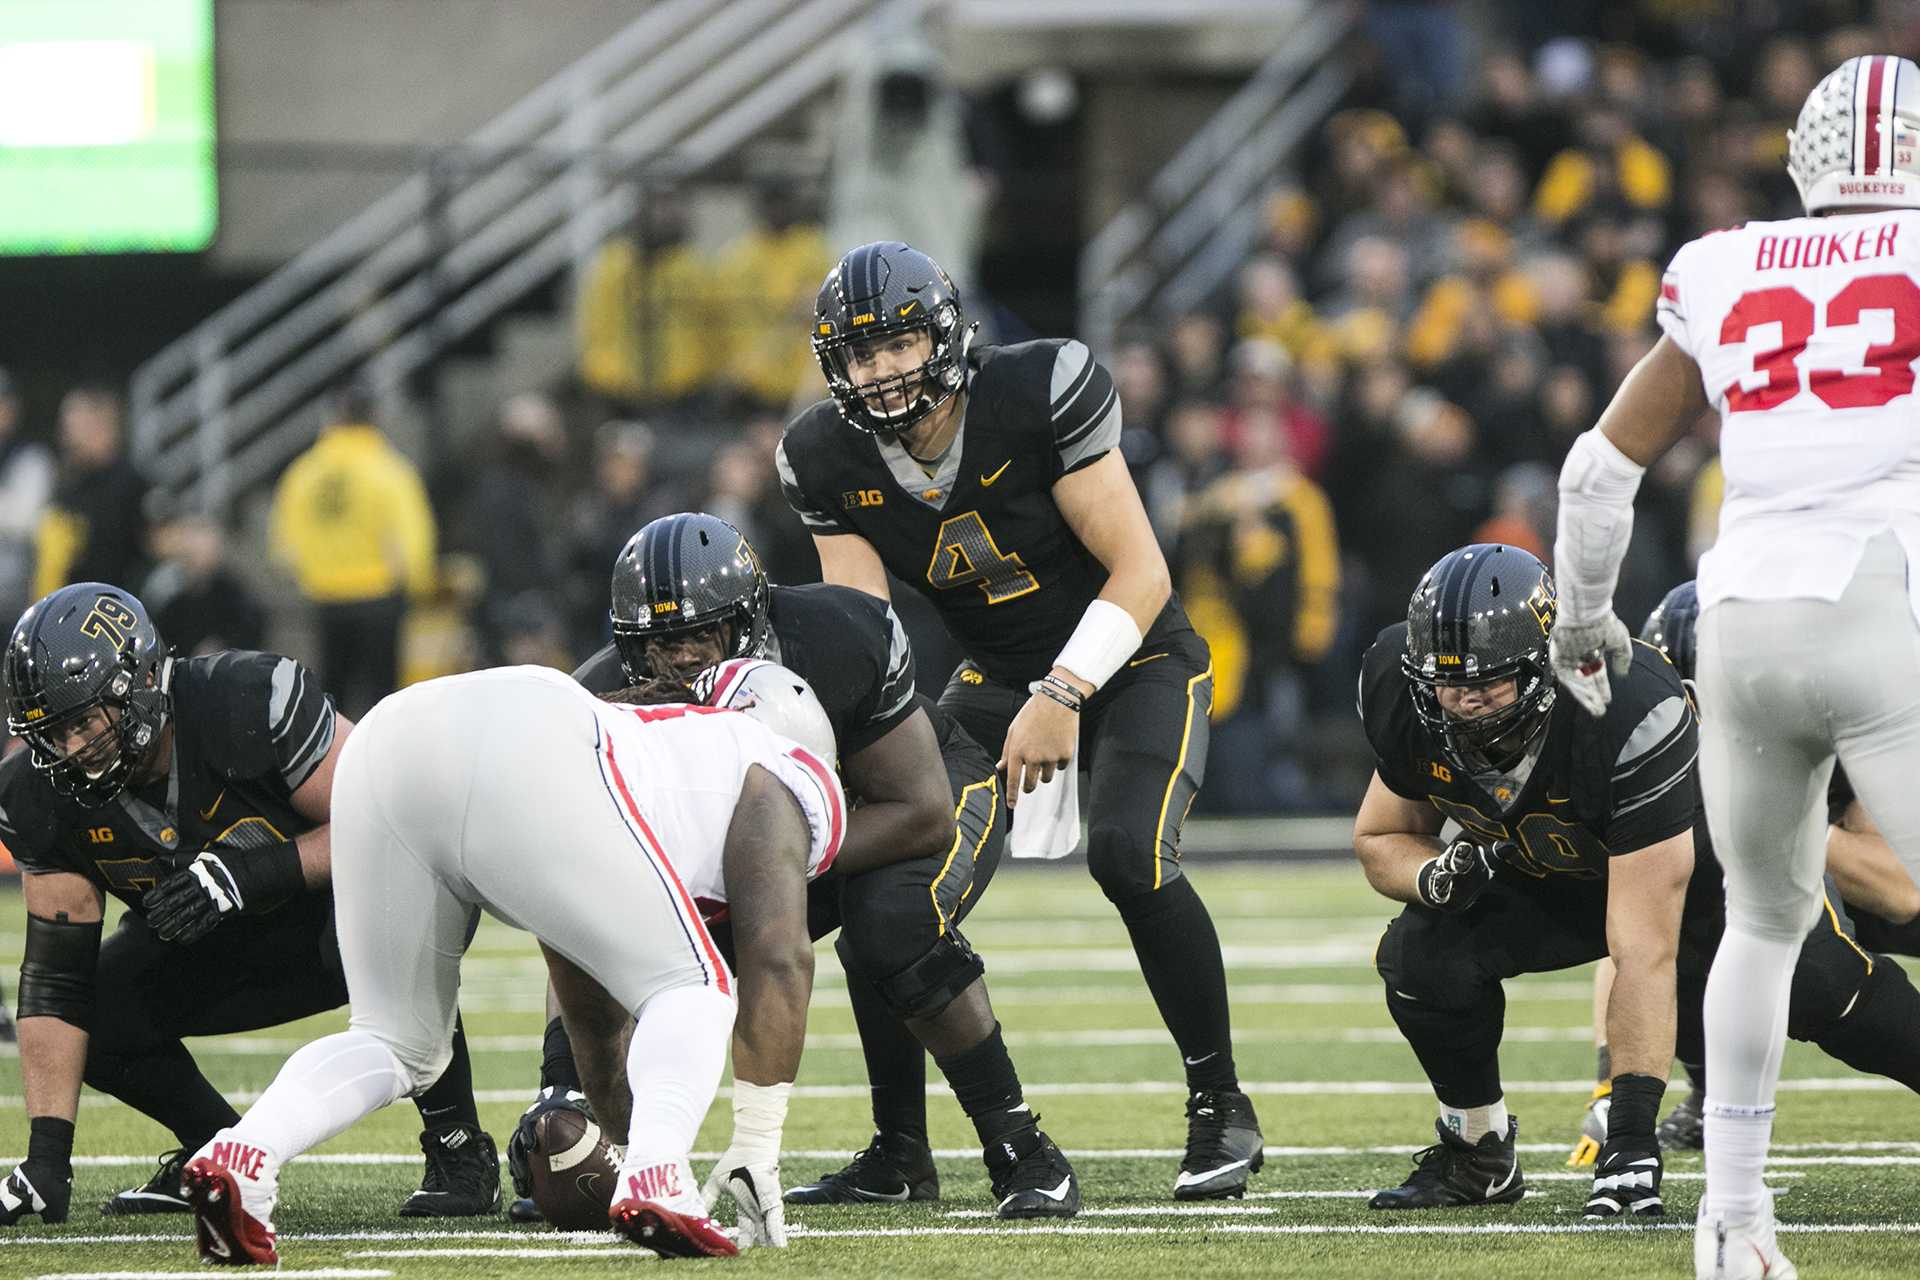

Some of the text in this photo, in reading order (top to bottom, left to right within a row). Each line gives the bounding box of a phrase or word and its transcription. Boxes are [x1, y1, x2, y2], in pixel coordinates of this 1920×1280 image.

[1898, 151, 1912, 163] 33
[1839, 182, 1905, 195] BUCKEYES
[1756, 222, 1899, 271] BOOKER
[852, 312, 876, 326] IOWA
[1719, 273, 1920, 413] 33
[926, 510, 1041, 605] 4
[80, 596, 138, 650] 79
[654, 601, 679, 614] IOWA
[1438, 655, 1462, 665] IOWA
[212, 1141, 268, 1182] NIKE
[628, 1163, 683, 1201] NIKE
